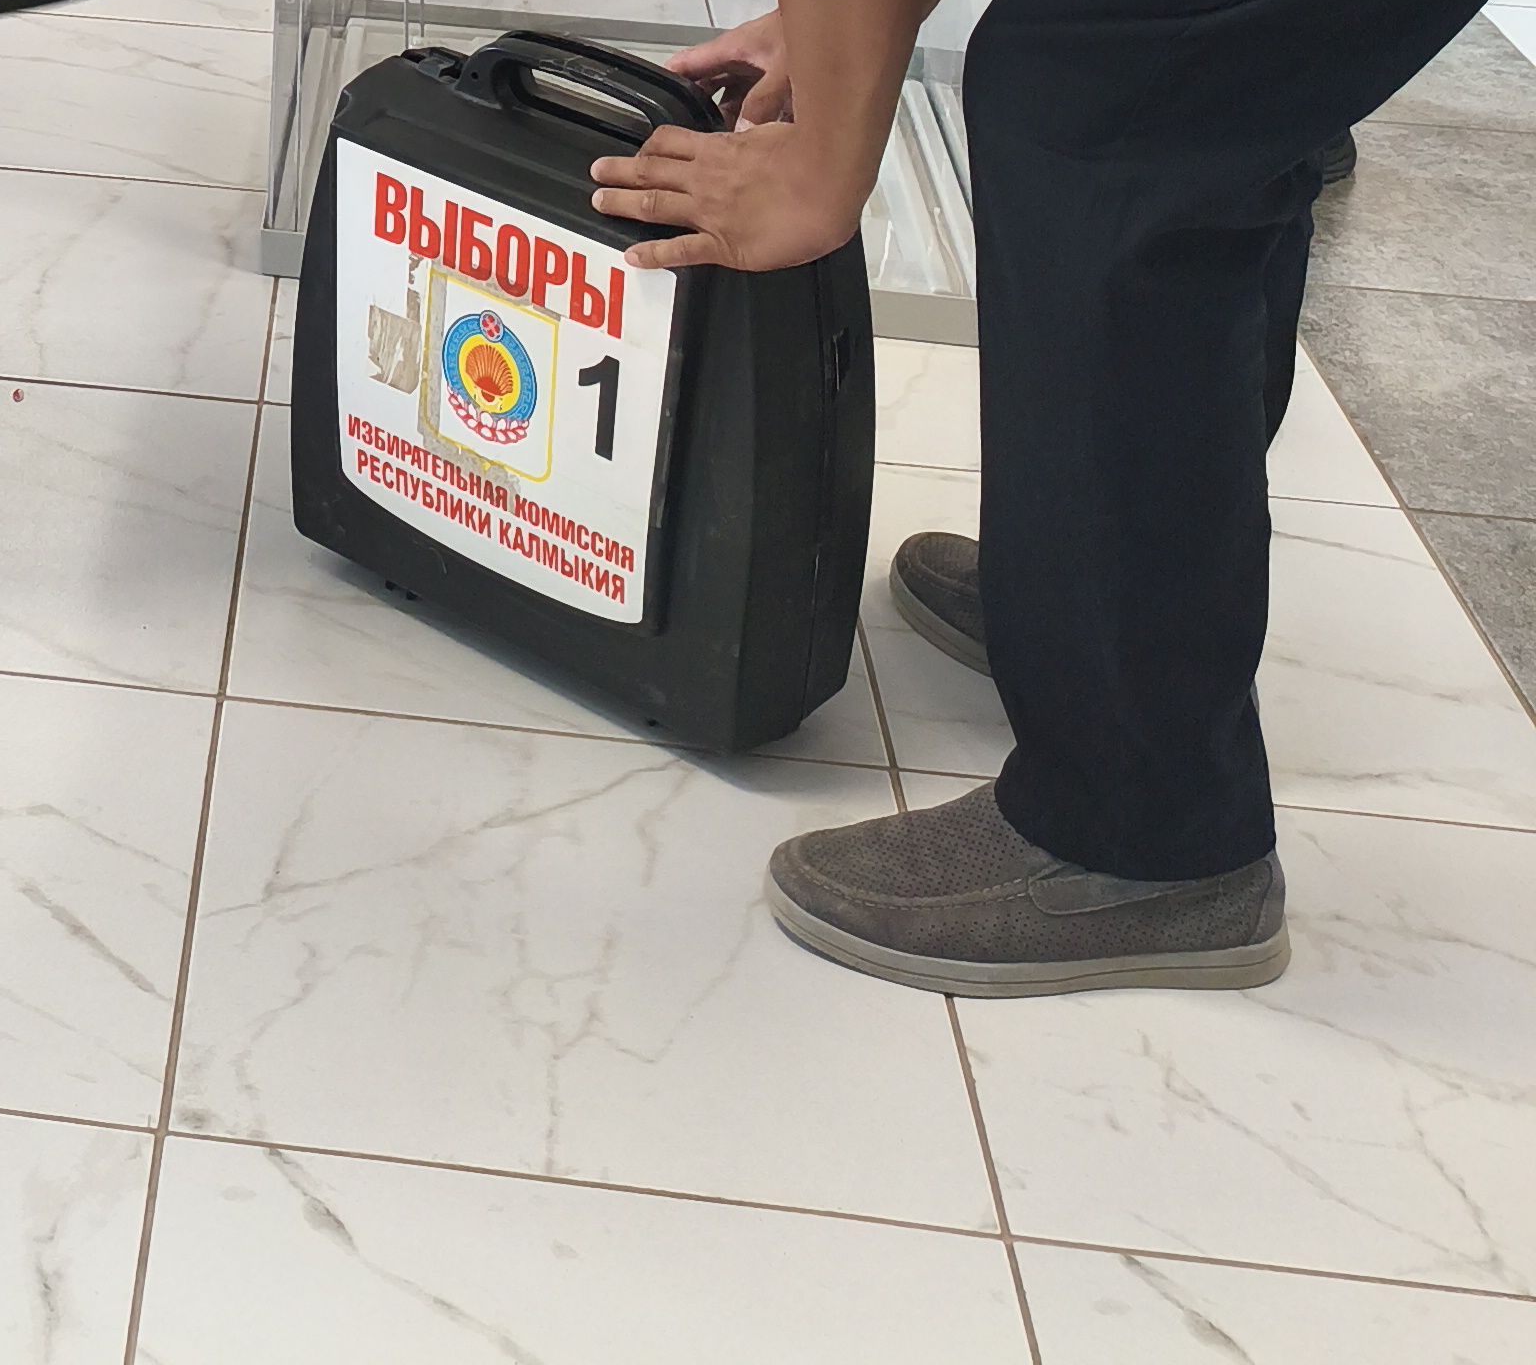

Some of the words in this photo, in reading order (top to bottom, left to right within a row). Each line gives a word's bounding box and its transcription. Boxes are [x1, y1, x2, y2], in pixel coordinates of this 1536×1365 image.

[374, 171, 625, 339] ВЫБОРЫ
[578, 354, 620, 461] 1
[346, 413, 507, 512] ИЗБИРАТЕЛЬНАЯ
[514, 493, 634, 572] КОМИССИЯ
[357, 448, 492, 539] РЕСПУБЛИКИ
[499, 518, 625, 604] КАЛМЫКИЯ
